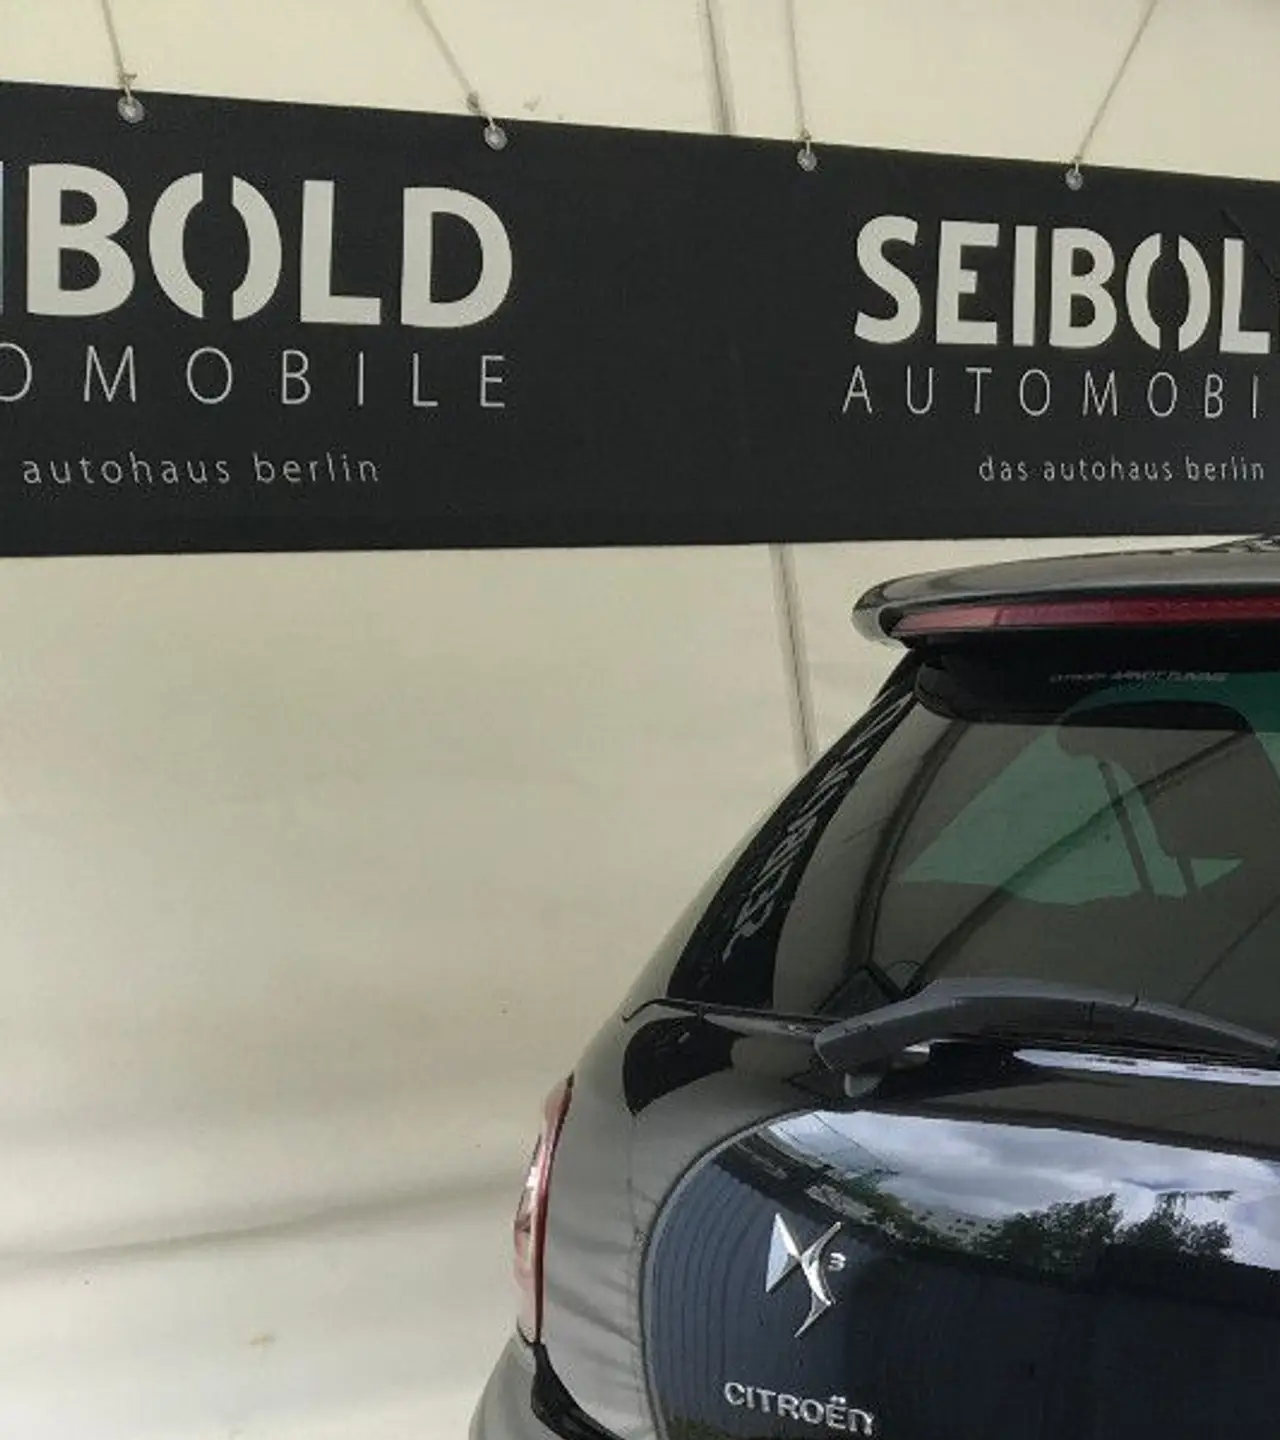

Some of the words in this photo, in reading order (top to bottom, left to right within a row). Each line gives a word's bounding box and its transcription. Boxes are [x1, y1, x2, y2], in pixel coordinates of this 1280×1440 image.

[0, 161, 512, 328] BOLD
[23, 452, 230, 484] autohaus
[253, 452, 379, 484] berlin
[978, 456, 1028, 482] das
[1043, 456, 1173, 482] autohaus
[1185, 455, 1264, 482] berlin
